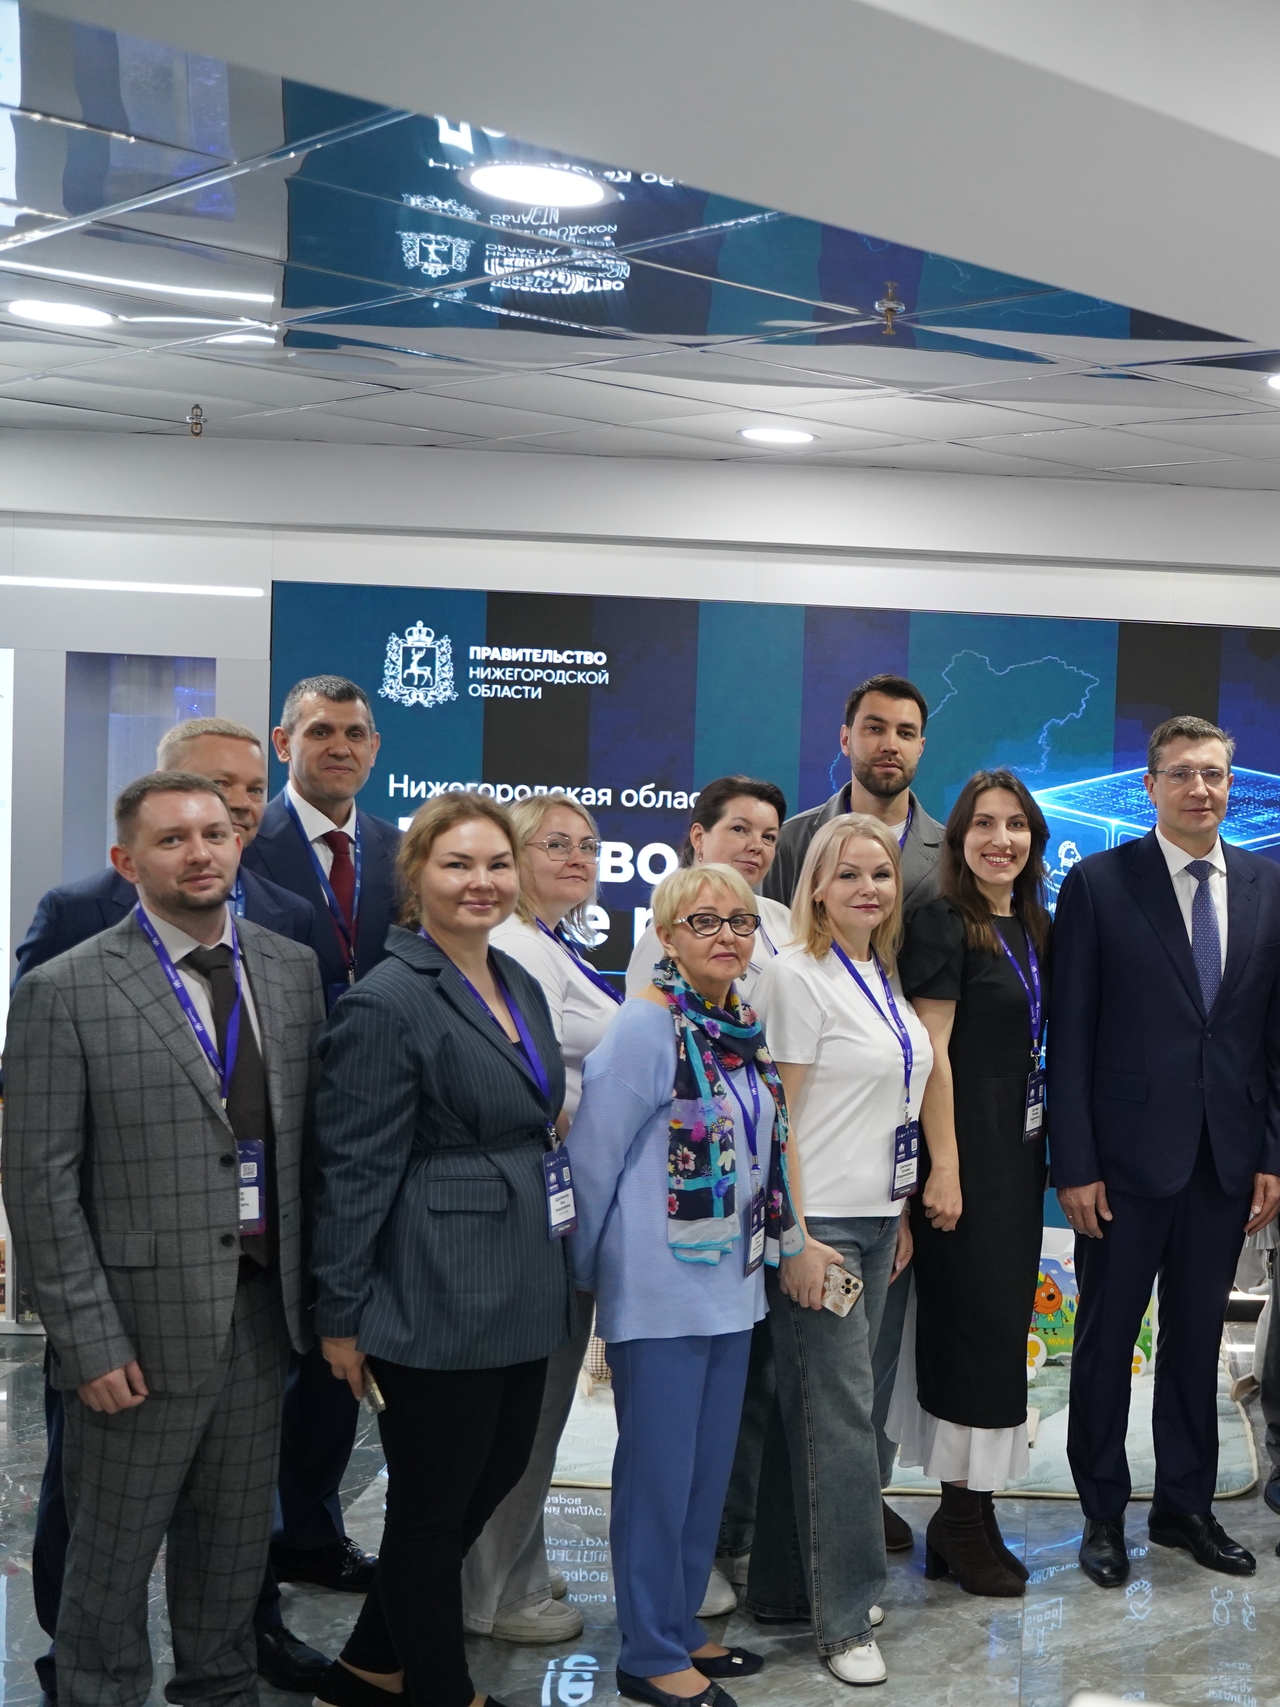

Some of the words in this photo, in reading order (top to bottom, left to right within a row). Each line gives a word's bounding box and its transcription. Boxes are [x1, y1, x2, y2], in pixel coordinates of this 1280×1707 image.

[469, 646, 608, 666] ПРАВИТЕЛЬСТВО
[469, 667, 610, 685] НИЖЕГОРОДСКОЙ
[468, 684, 543, 699] ОБЛАСТИ
